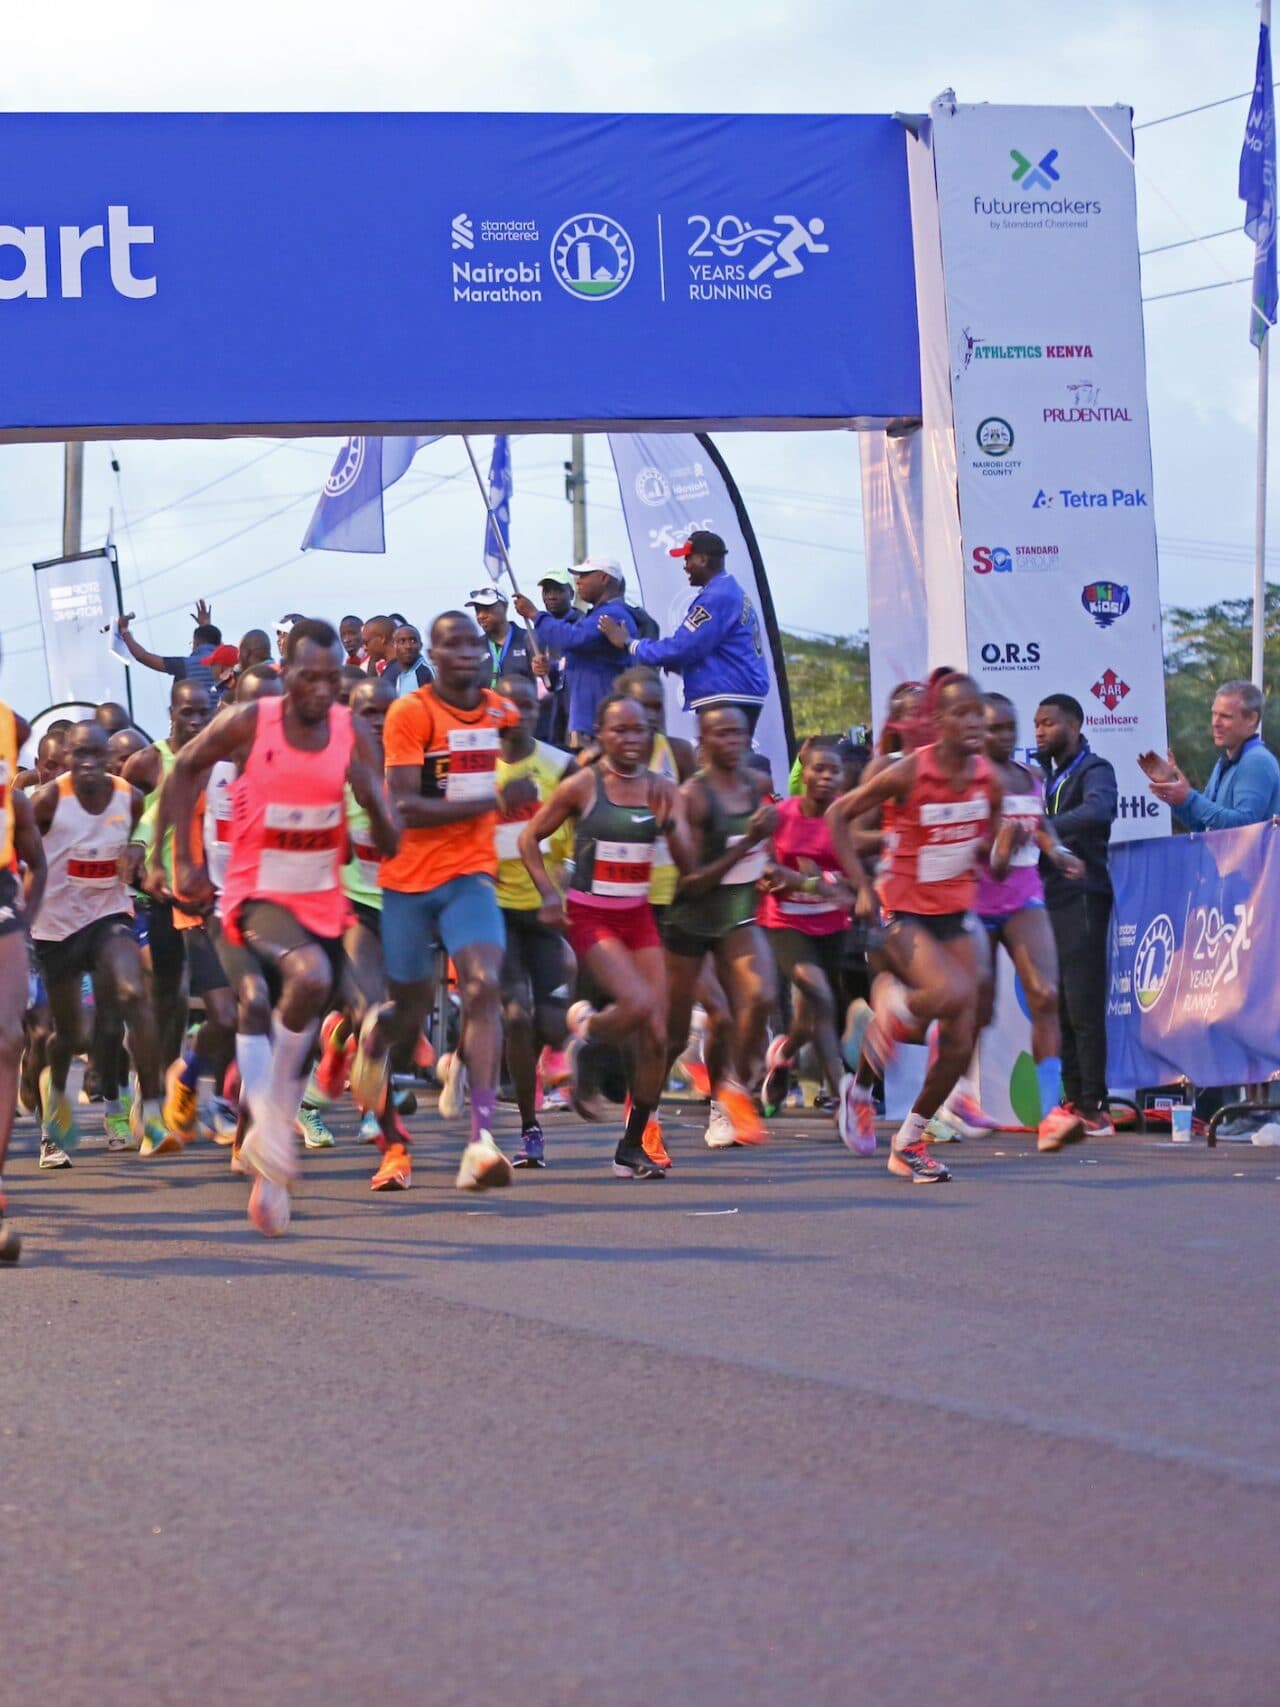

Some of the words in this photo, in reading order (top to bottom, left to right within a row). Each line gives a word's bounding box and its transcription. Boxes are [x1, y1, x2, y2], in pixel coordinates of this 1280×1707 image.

[973, 196, 1102, 214] futuremakers
[481, 220, 536, 231] standard
[990, 220, 1001, 230] by
[1003, 220, 1043, 229] Standard
[1045, 220, 1088, 229] Chartered
[481, 230, 540, 242] chartered
[688, 215, 746, 256] 20
[452, 262, 541, 283] Nairobi
[689, 265, 745, 281] YEARS
[453, 286, 542, 302] Marathon
[689, 284, 772, 300] RUNNING
[974, 346, 1042, 359] ATHLETICS
[1046, 345, 1093, 358] KENYA
[1043, 407, 1133, 423] PRUDENTIAL
[1060, 490, 1108, 507] Tetra
[1112, 489, 1147, 506] Pak
[1015, 545, 1059, 555] STANDARD
[973, 546, 1013, 574] SG
[981, 642, 1041, 664] O.R.S
[1086, 714, 1139, 725] Healthcare
[1115, 796, 1160, 819] ttle
